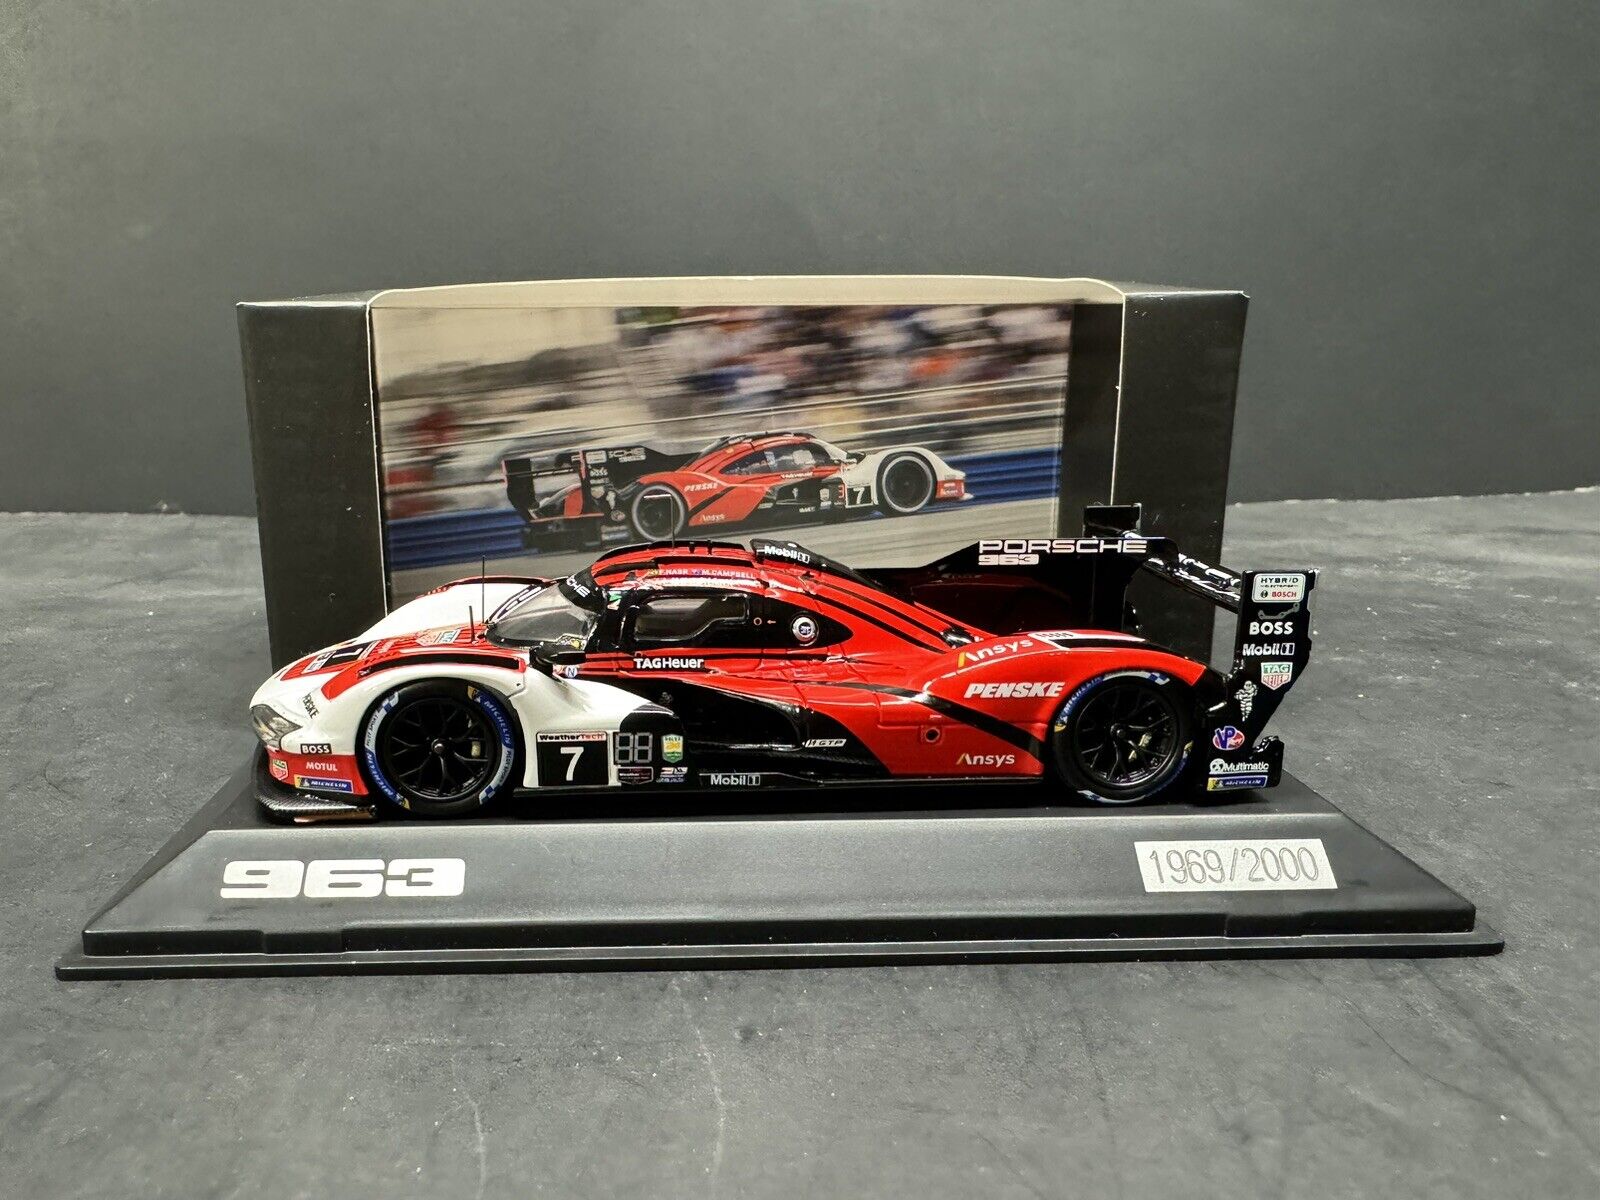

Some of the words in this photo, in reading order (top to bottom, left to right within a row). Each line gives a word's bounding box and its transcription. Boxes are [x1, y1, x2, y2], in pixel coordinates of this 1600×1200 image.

[853, 487, 865, 505] 7
[978, 540, 1148, 554] PORSCHE
[978, 554, 1039, 566] 963
[1249, 621, 1294, 636] BOSS
[957, 637, 1035, 668] Ansys
[1264, 664, 1290, 674] TAG
[964, 682, 1066, 698] PENSKE
[484, 700, 511, 745] MICHELIN
[539, 733, 605, 741] WeatherTech
[301, 744, 330, 754] BOSS
[305, 761, 338, 772] MOTUL
[560, 746, 584, 781] 7
[956, 752, 1016, 768] Ansys
[1223, 761, 1270, 772] Multimatic
[311, 780, 348, 788] MICHELIN
[1149, 846, 1319, 884] 1969/2000
[220, 858, 466, 898] 963
